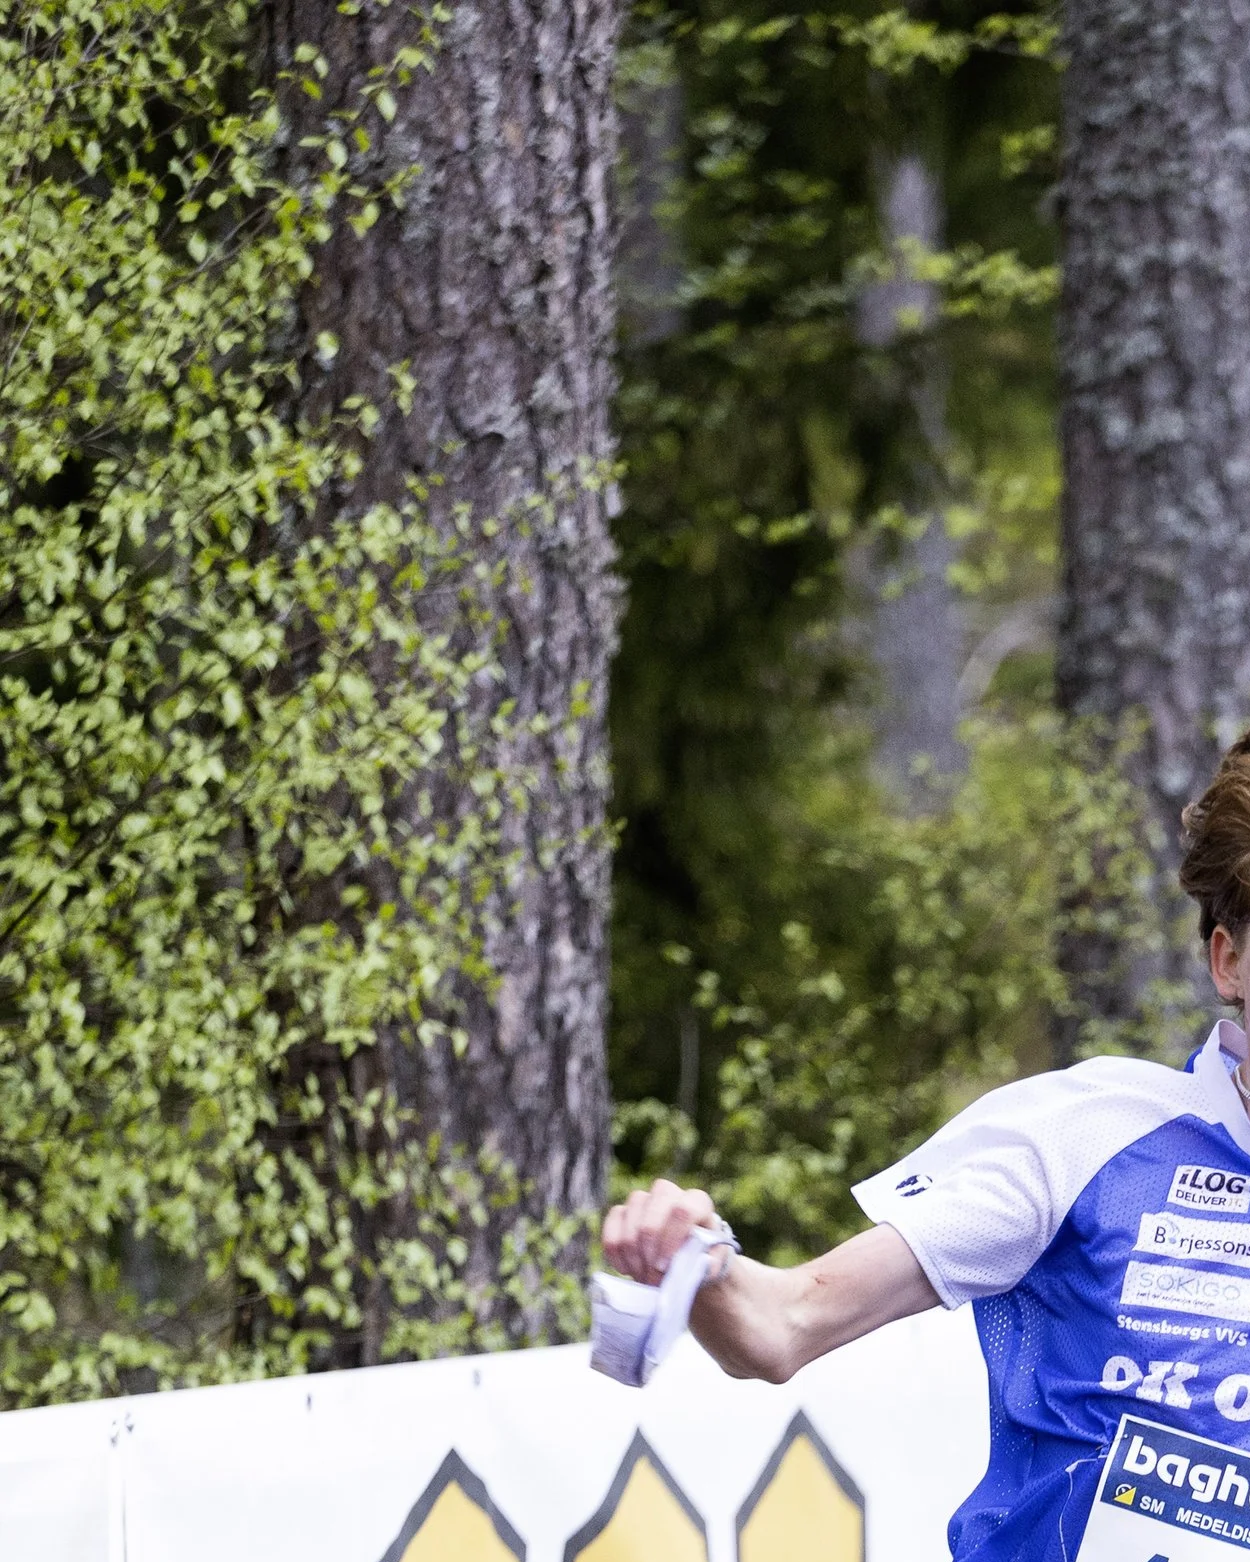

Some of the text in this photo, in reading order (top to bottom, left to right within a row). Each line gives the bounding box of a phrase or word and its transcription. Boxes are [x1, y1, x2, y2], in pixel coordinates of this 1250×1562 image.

[1175, 1188, 1227, 1207] DELIVER
[1139, 1271, 1241, 1301] SOKIGO
[1215, 1326, 1249, 1348] VVS
[1099, 1355, 1199, 1409] OK
[1138, 1495, 1166, 1516] SM
